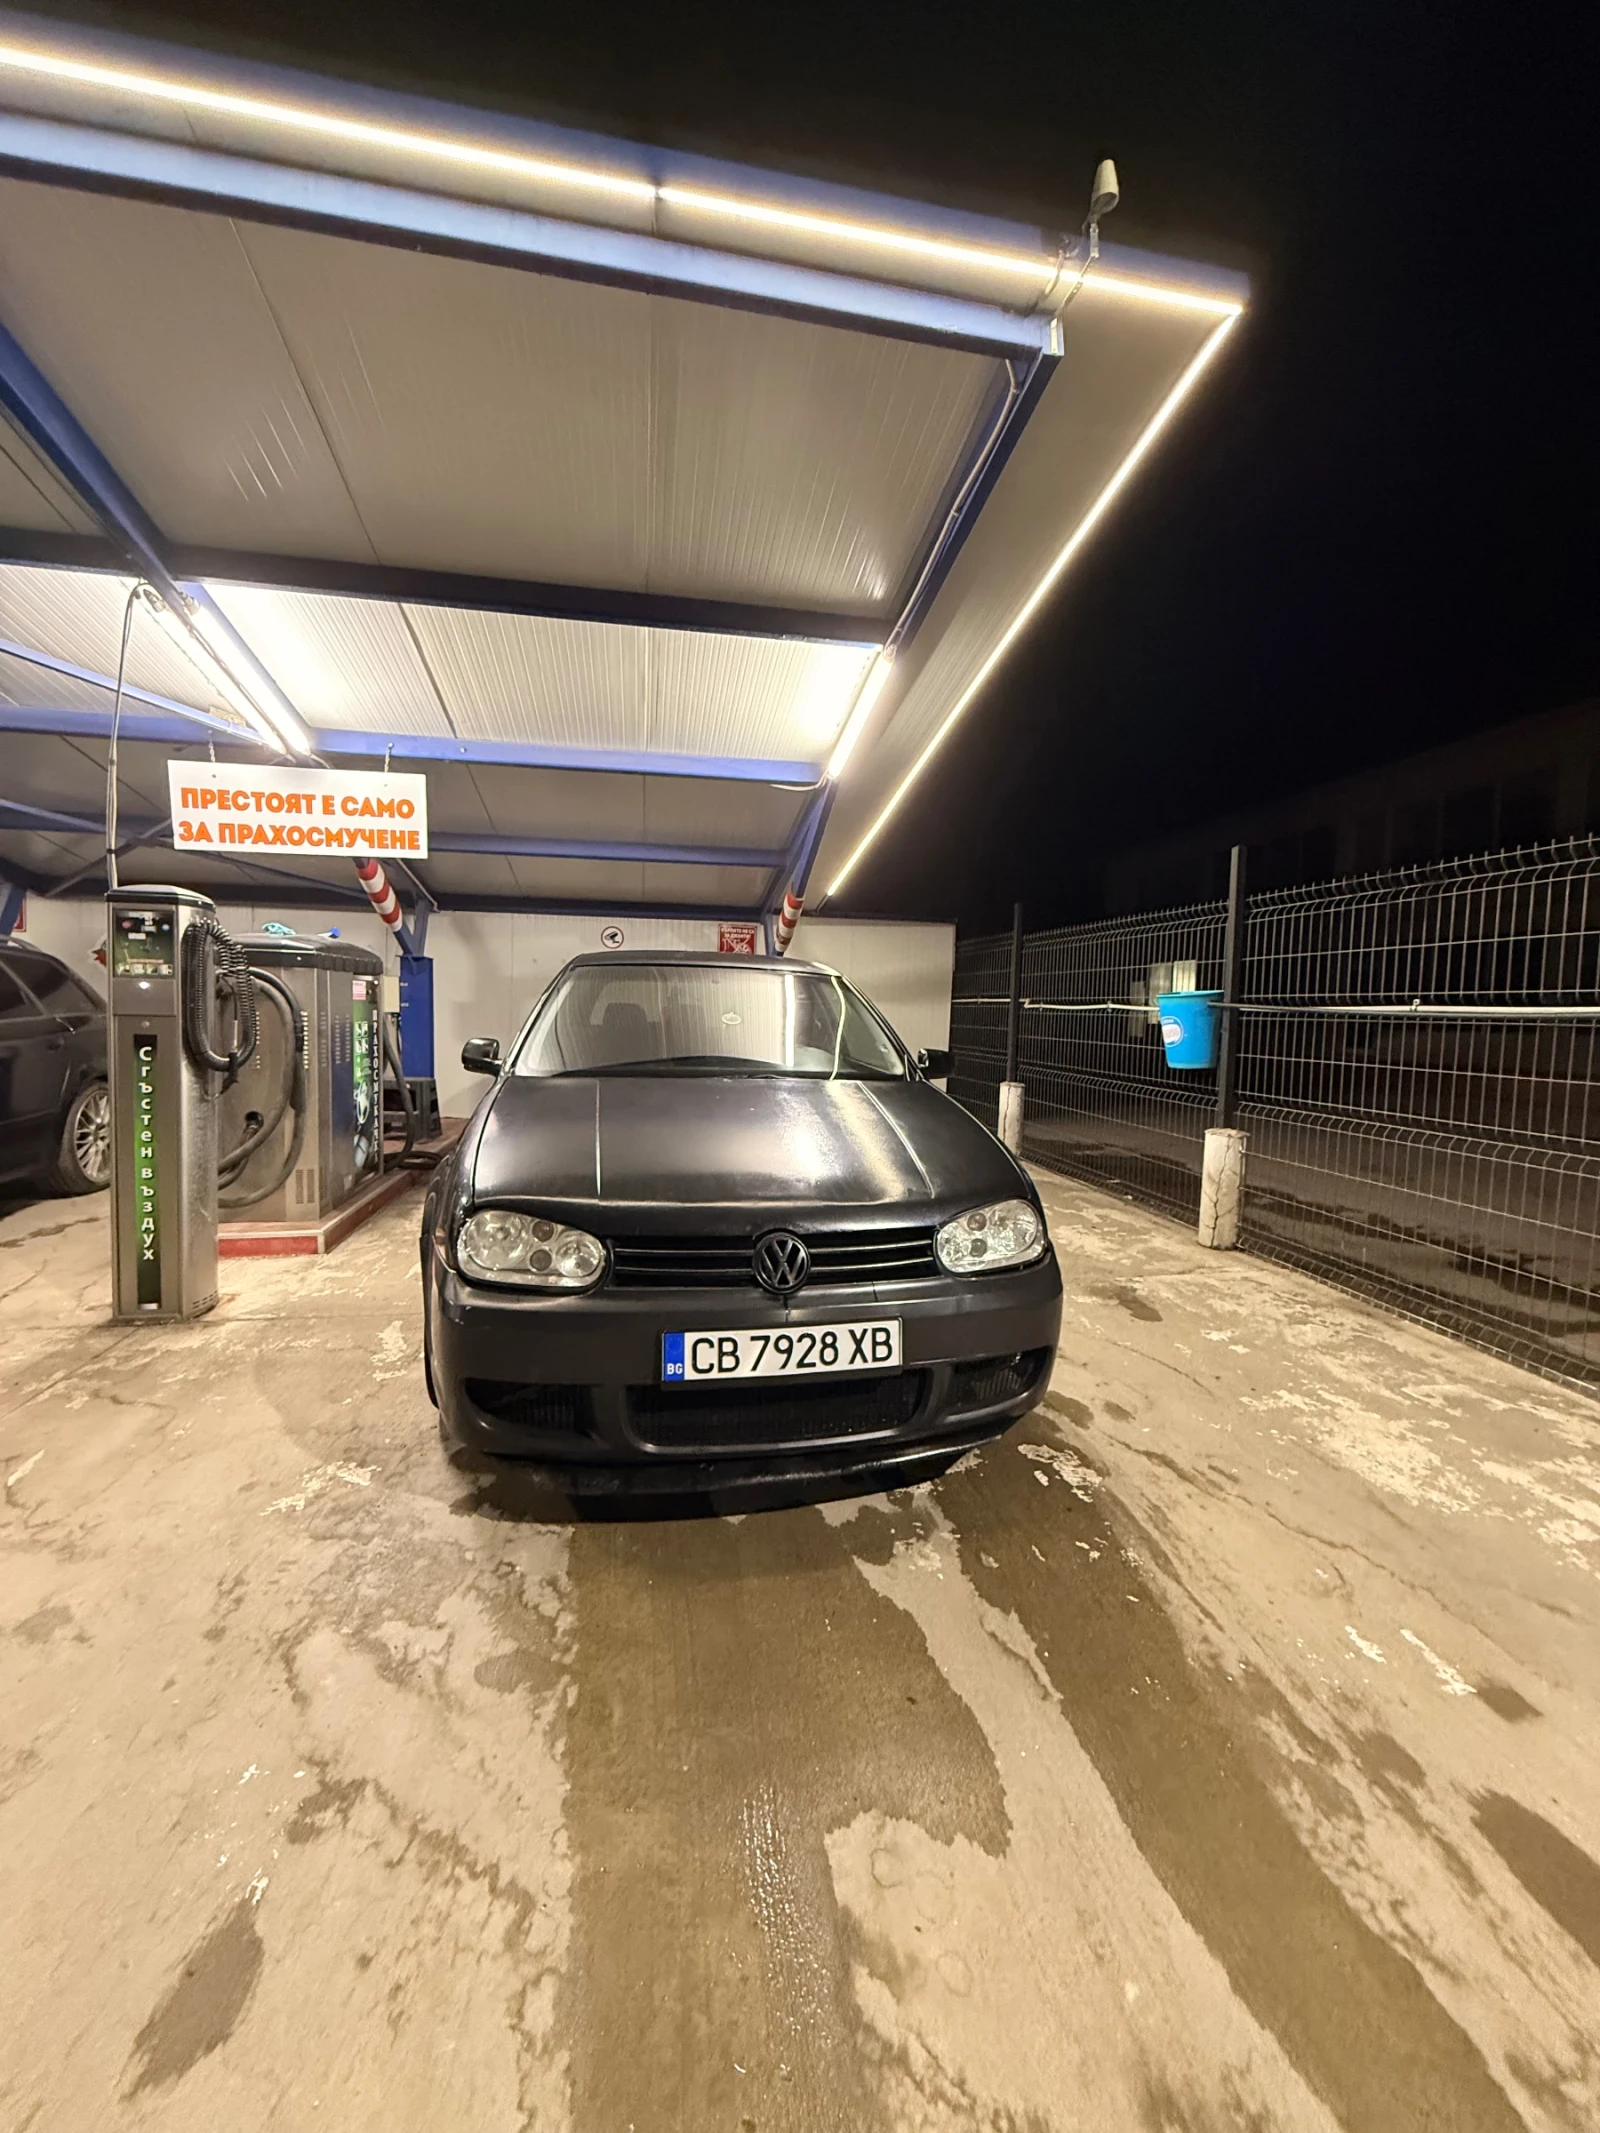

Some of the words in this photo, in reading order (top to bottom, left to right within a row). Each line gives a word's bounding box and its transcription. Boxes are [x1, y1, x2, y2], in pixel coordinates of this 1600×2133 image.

[180, 787, 316, 815] ПРЕСТОЯТ
[322, 795, 336, 816] Е
[341, 796, 415, 819] САМО
[178, 821, 213, 843] ЗА
[218, 823, 420, 850] ПРАХОСМУЧЕНЕ
[138, 1046, 153, 1158] Сгъстен
[140, 1168, 155, 1260] въздух
[666, 1363, 683, 1375] BG
[691, 1337, 740, 1374] CB
[750, 1331, 839, 1372] 7928
[848, 1327, 893, 1365] XB
